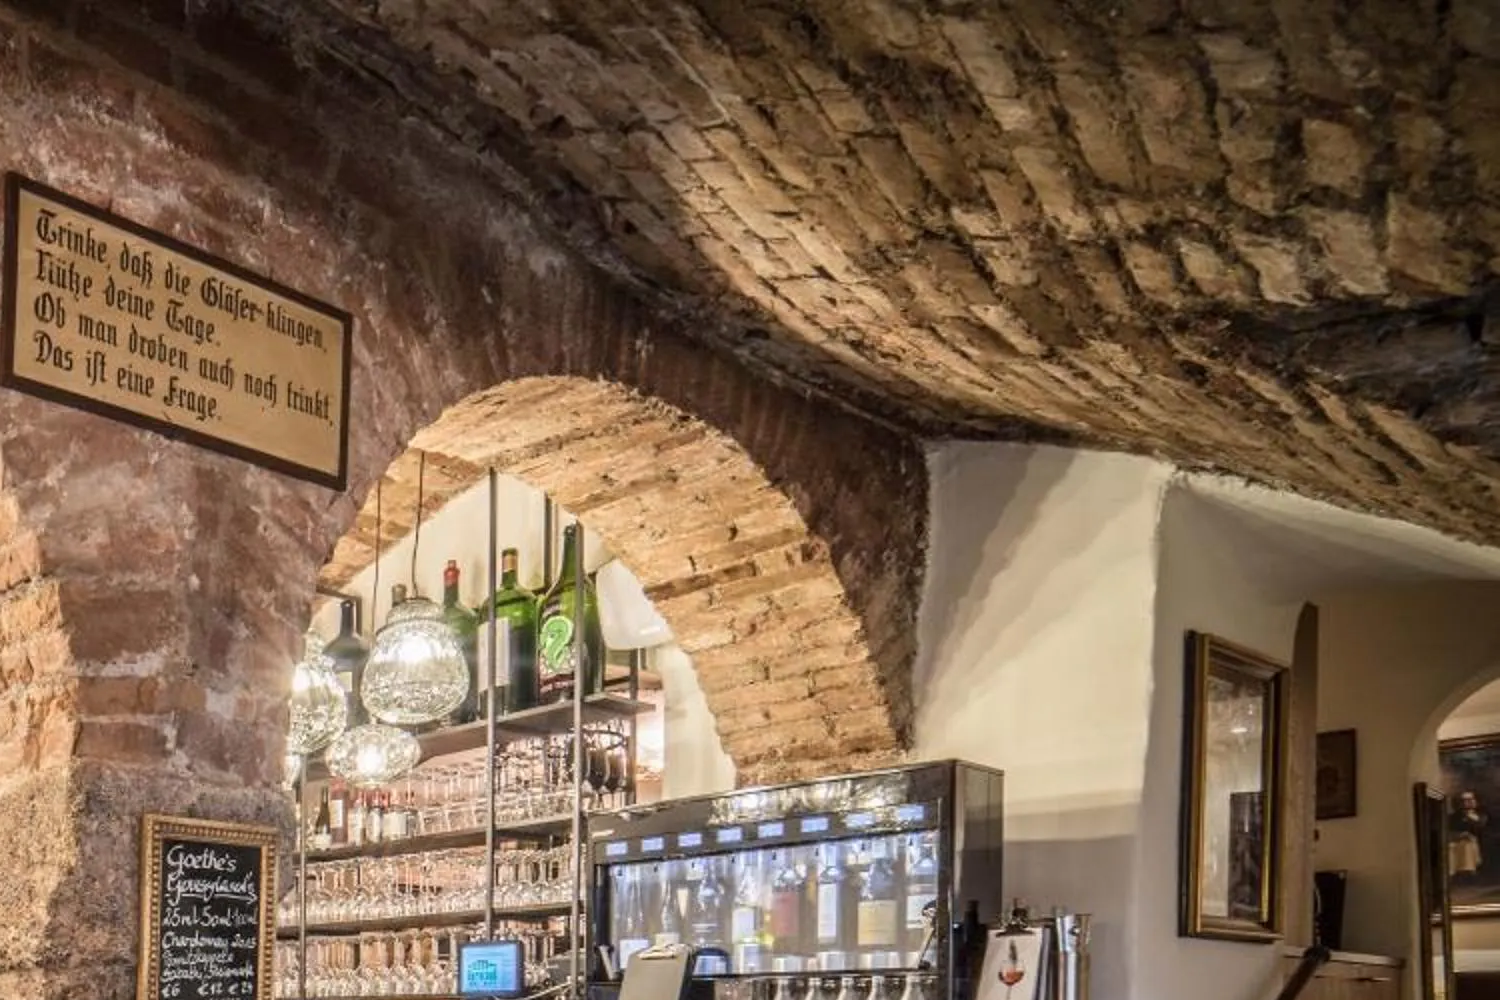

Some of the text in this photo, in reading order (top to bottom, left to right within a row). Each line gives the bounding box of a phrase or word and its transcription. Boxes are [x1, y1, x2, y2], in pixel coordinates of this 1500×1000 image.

[36, 208, 327, 353] Trinke, daß die Gläser klingen,
[105, 275, 154, 320] deine
[166, 299, 221, 347] Tage.
[33, 330, 222, 421] Das ist eine Frage.
[34, 292, 333, 427] Ob man droben auch noch trinkt,
[167, 845, 237, 875] Goethe's
